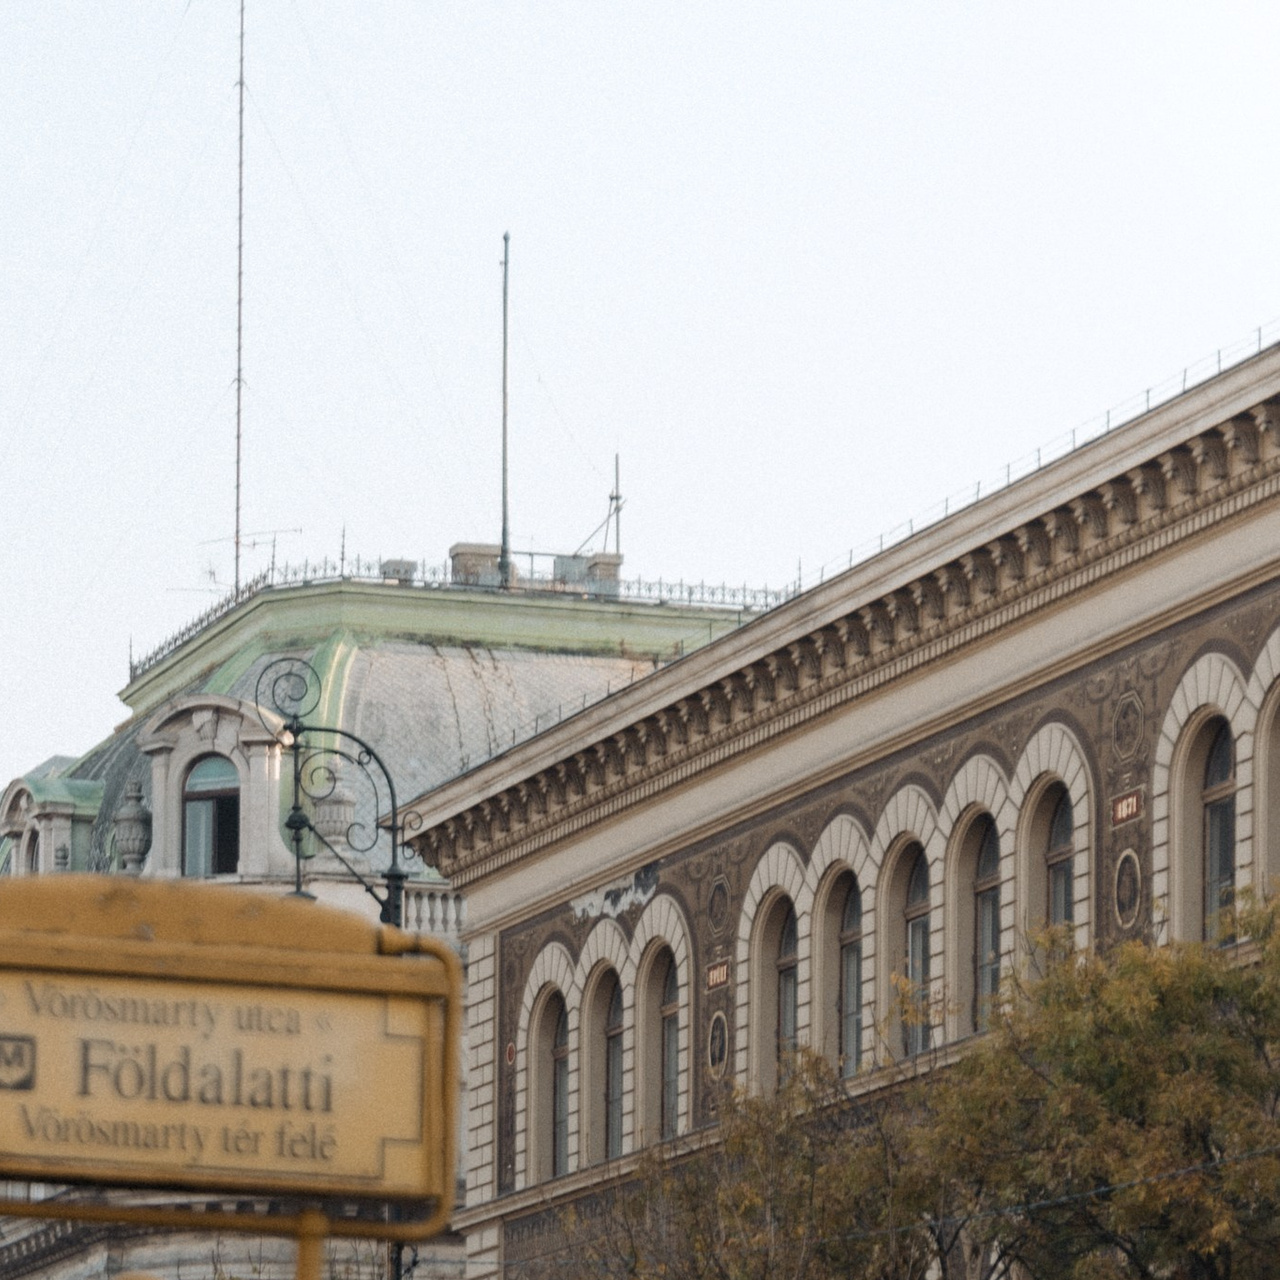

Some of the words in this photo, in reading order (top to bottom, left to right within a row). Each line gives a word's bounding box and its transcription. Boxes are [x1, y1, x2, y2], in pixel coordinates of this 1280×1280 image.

[23, 979, 218, 1041] Vörösmarty
[235, 1001, 302, 1035] utca
[77, 1036, 334, 1113] Földalatti
[18, 1102, 209, 1165] Vörösmarty
[222, 1118, 265, 1154] tér
[274, 1120, 338, 1162] felé
